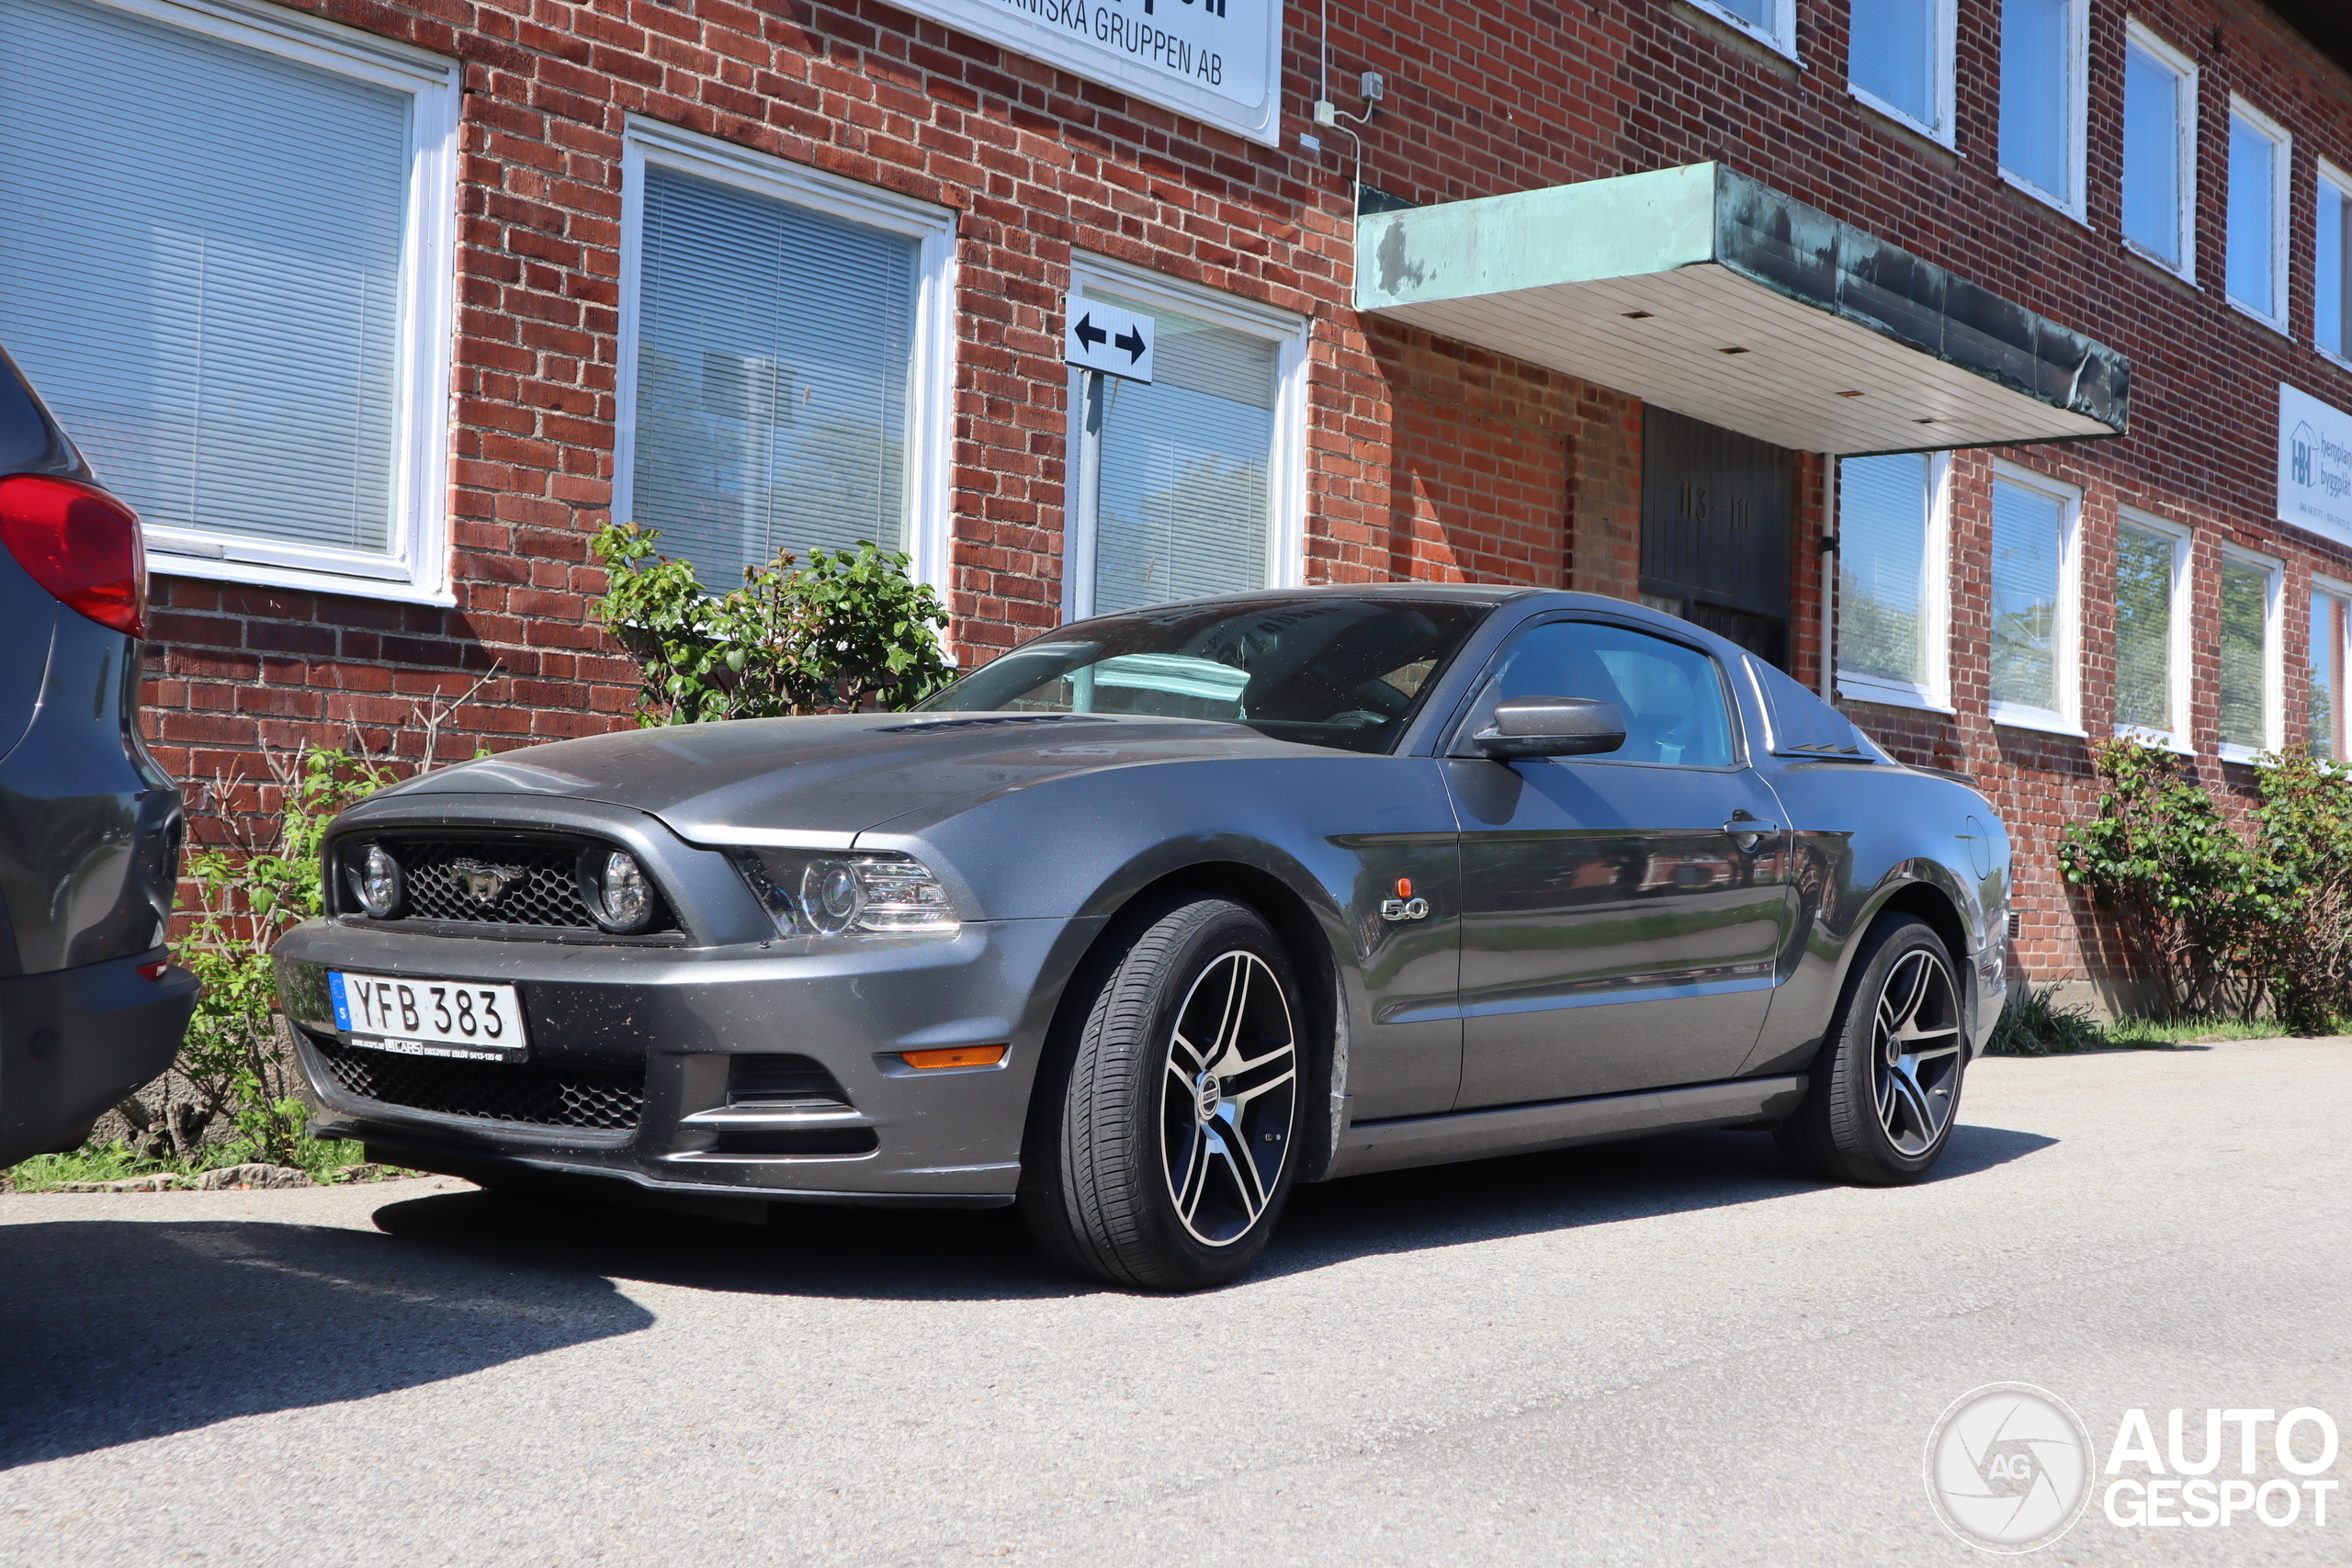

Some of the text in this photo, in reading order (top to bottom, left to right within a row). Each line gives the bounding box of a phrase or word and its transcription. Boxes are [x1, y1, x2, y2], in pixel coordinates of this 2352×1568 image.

[1095, 6, 1192, 74] GRUPPEN
[1197, 50, 1222, 85] AB
[2321, 461, 2351, 500] byggplåt
[1381, 897, 1430, 921] 5.0
[339, 1007, 346, 1020] S
[354, 980, 503, 1038] YFB 383
[424, 1048, 450, 1057] EXCLUSIVE
